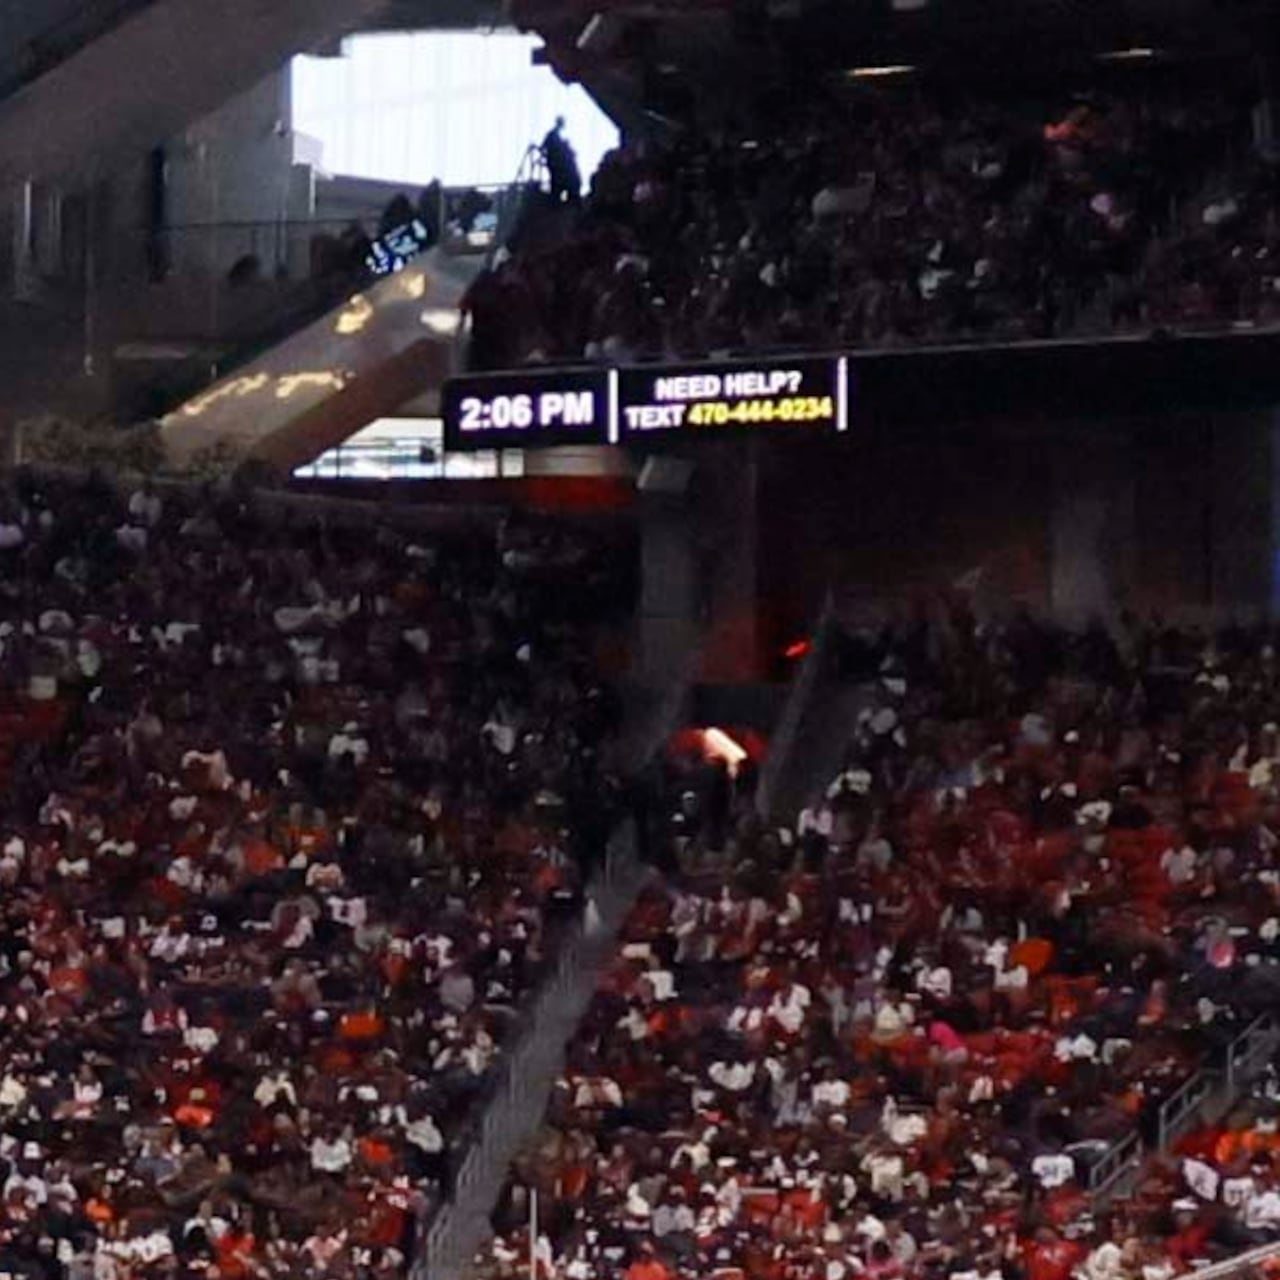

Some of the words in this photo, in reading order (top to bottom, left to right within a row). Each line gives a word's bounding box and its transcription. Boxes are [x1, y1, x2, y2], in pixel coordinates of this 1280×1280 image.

[655, 374, 720, 400] NEED
[724, 370, 802, 396] HELP?
[460, 396, 533, 430] 2:06
[540, 392, 594, 425] PM
[625, 404, 687, 430] TEXT
